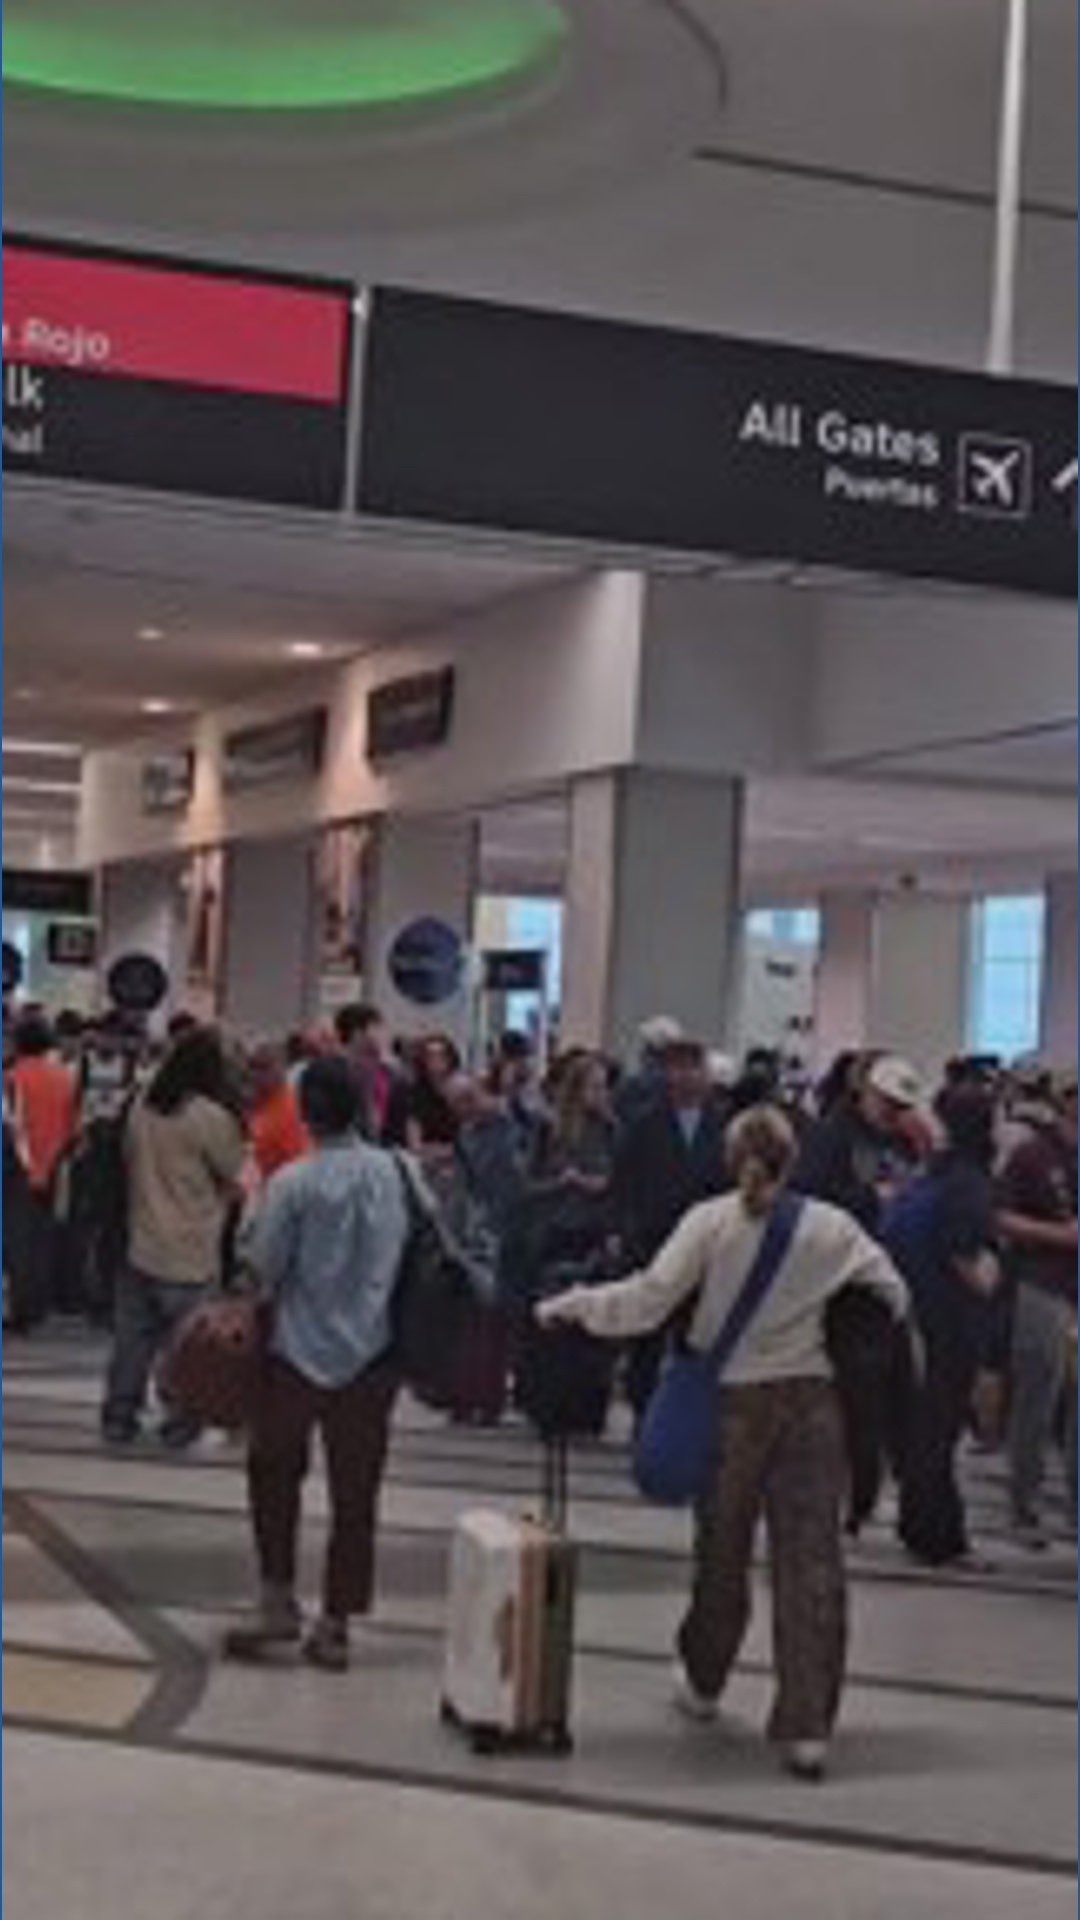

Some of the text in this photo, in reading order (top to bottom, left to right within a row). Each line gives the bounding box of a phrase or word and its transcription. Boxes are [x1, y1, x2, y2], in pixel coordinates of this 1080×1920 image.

[25, 318, 109, 365] Rojo
[739, 403, 940, 465] All Gates
